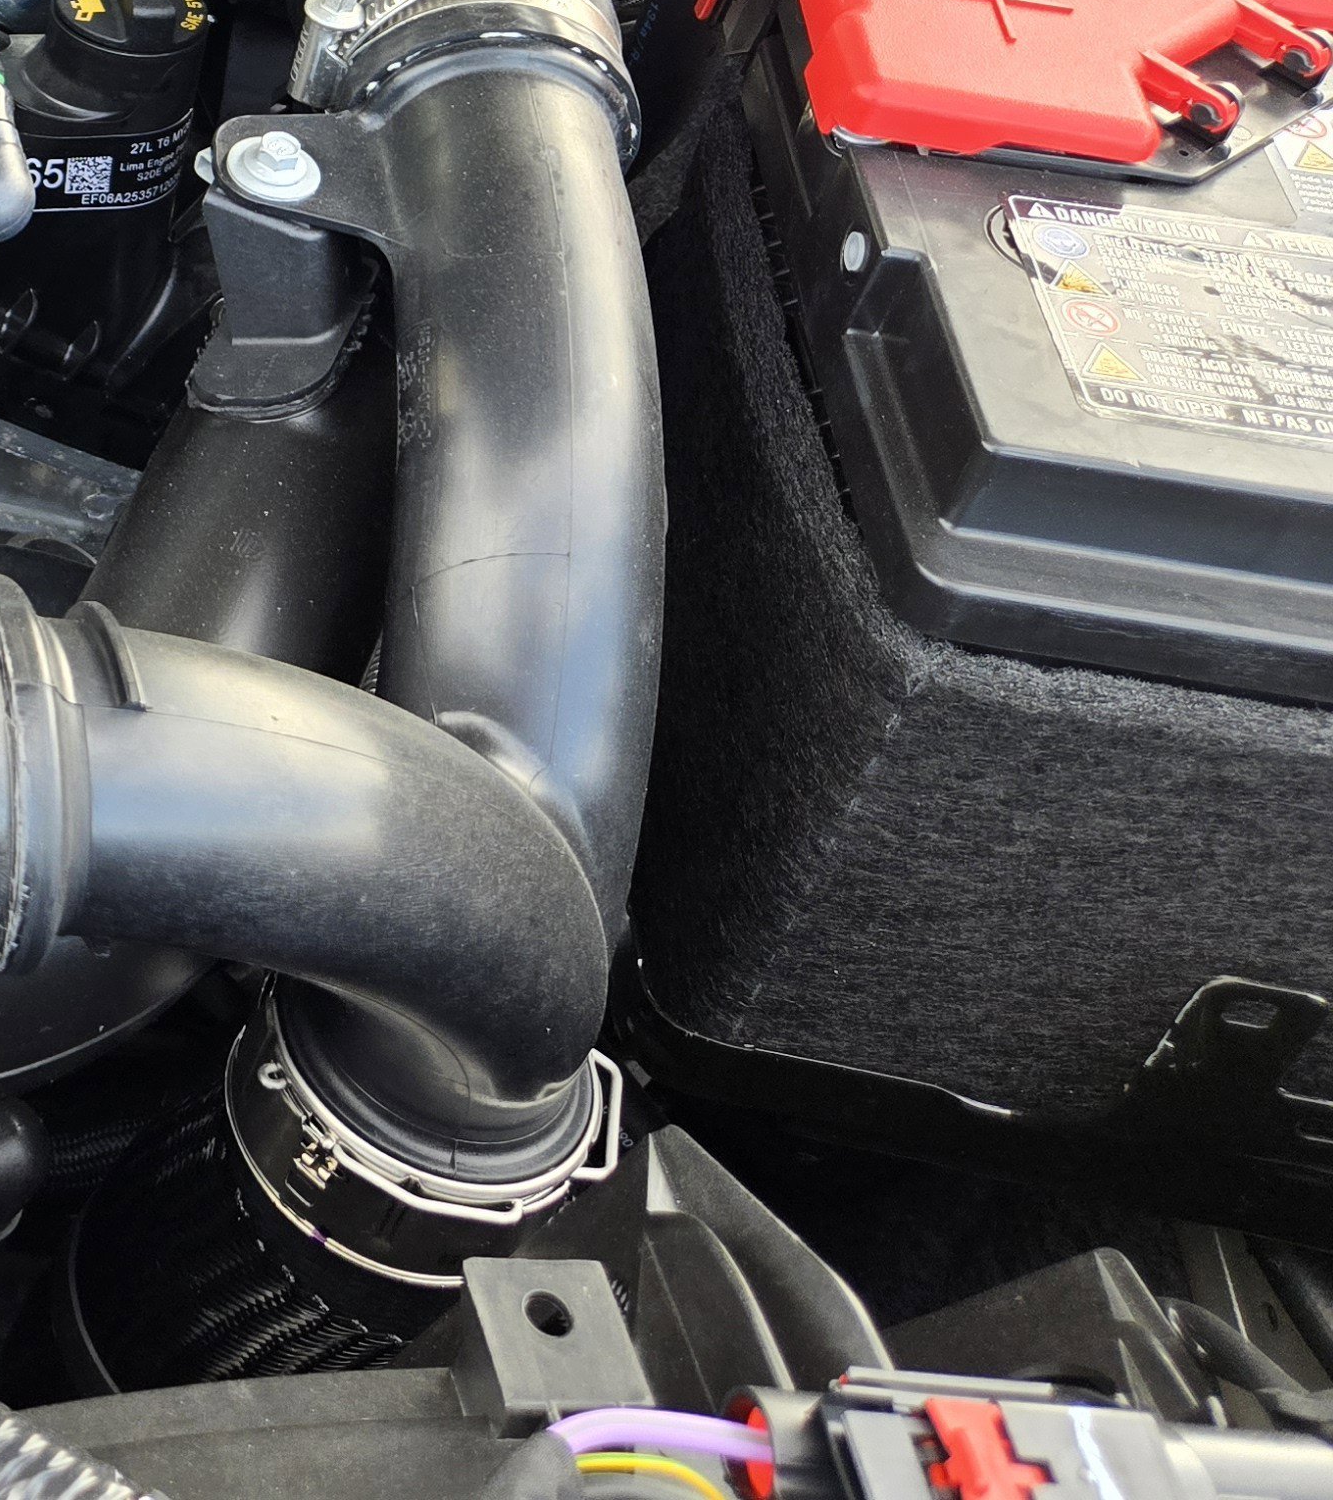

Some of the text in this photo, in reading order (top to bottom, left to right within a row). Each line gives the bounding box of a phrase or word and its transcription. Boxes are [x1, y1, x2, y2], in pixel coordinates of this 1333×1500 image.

[180, 11, 204, 30] SAE
[130, 142, 153, 155] 27L
[157, 137, 170, 149] T6
[120, 162, 144, 172] Lima
[1201, 358, 1231, 373] ACID
[1099, 387, 1129, 405] DO
[1132, 392, 1171, 410] NOT
[1241, 408, 1270, 426] NE
[1272, 412, 1313, 433] PAS
